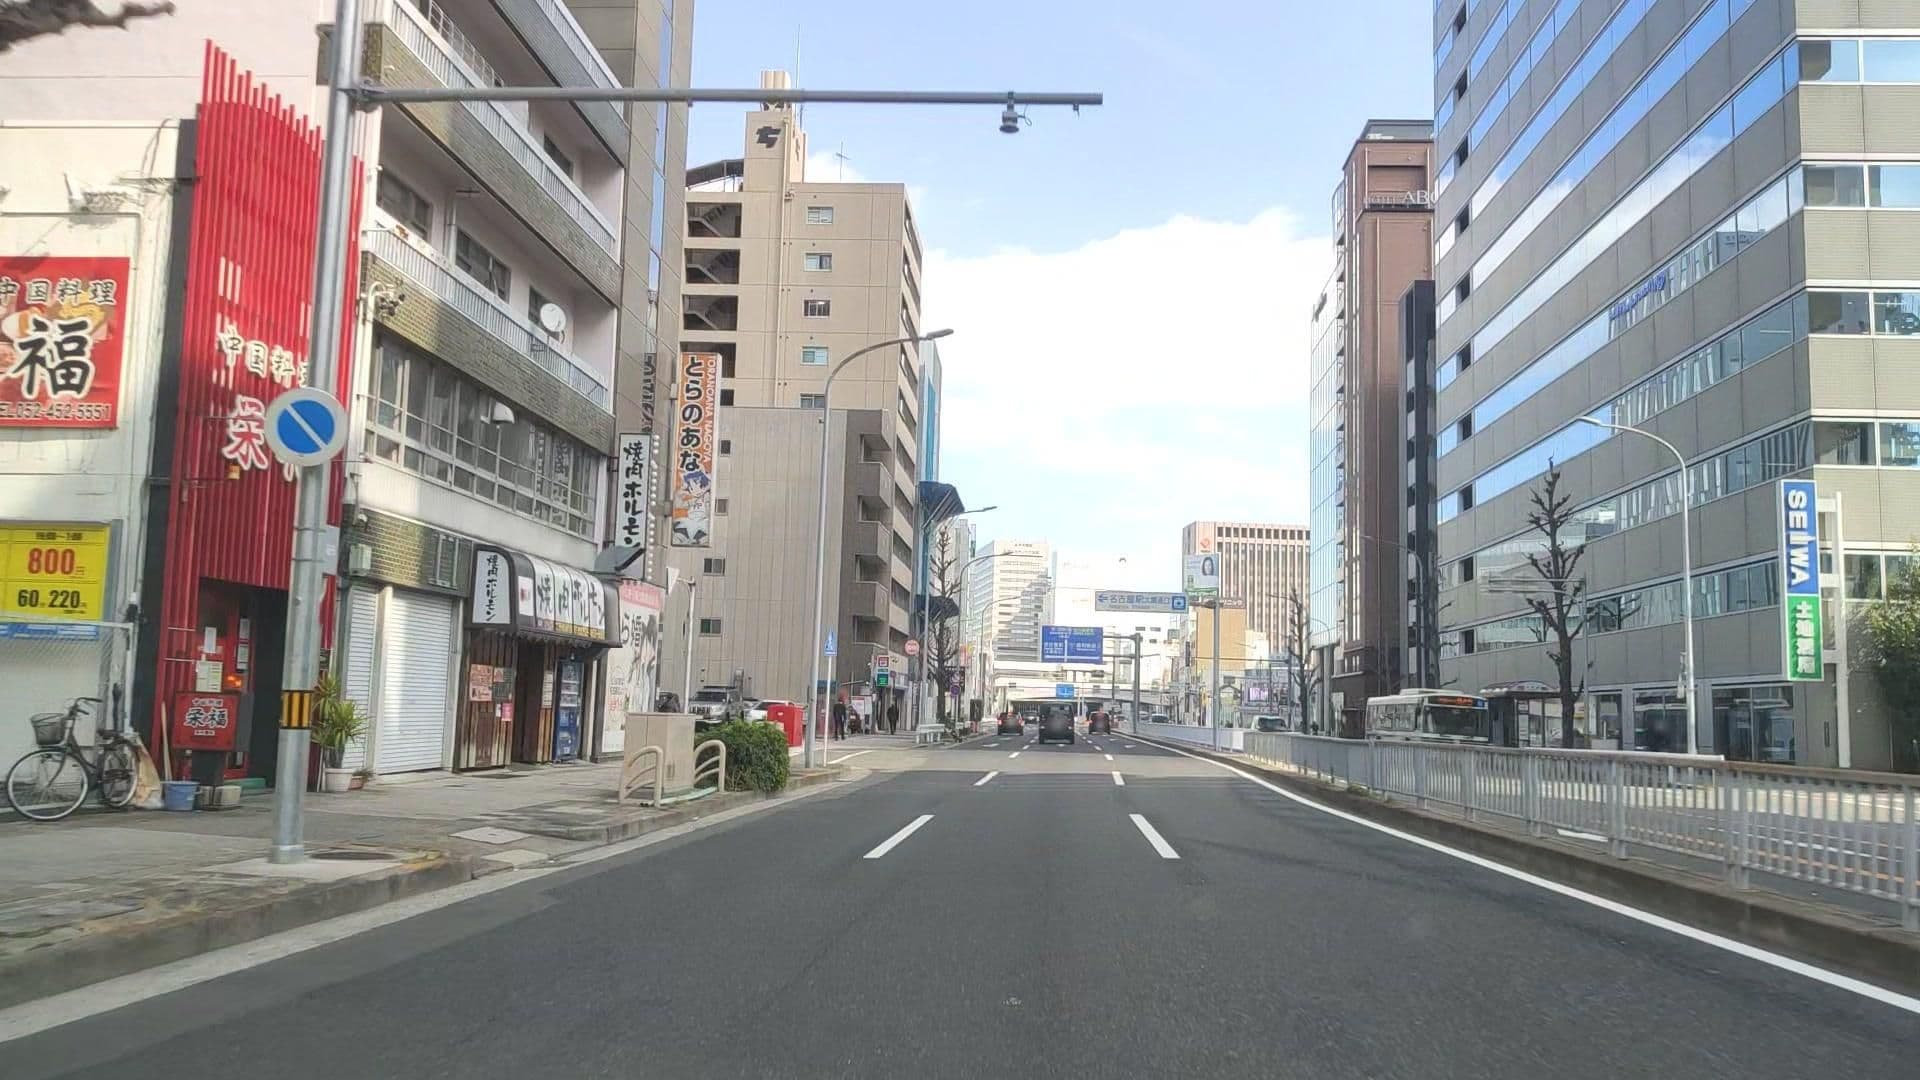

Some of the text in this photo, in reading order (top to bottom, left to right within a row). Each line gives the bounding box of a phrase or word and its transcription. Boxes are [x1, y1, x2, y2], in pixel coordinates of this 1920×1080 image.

[679, 355, 704, 472] とらのあな
[703, 355, 717, 463] TORANOANA NAGOYA
[1788, 490, 1816, 585] SEIWA
